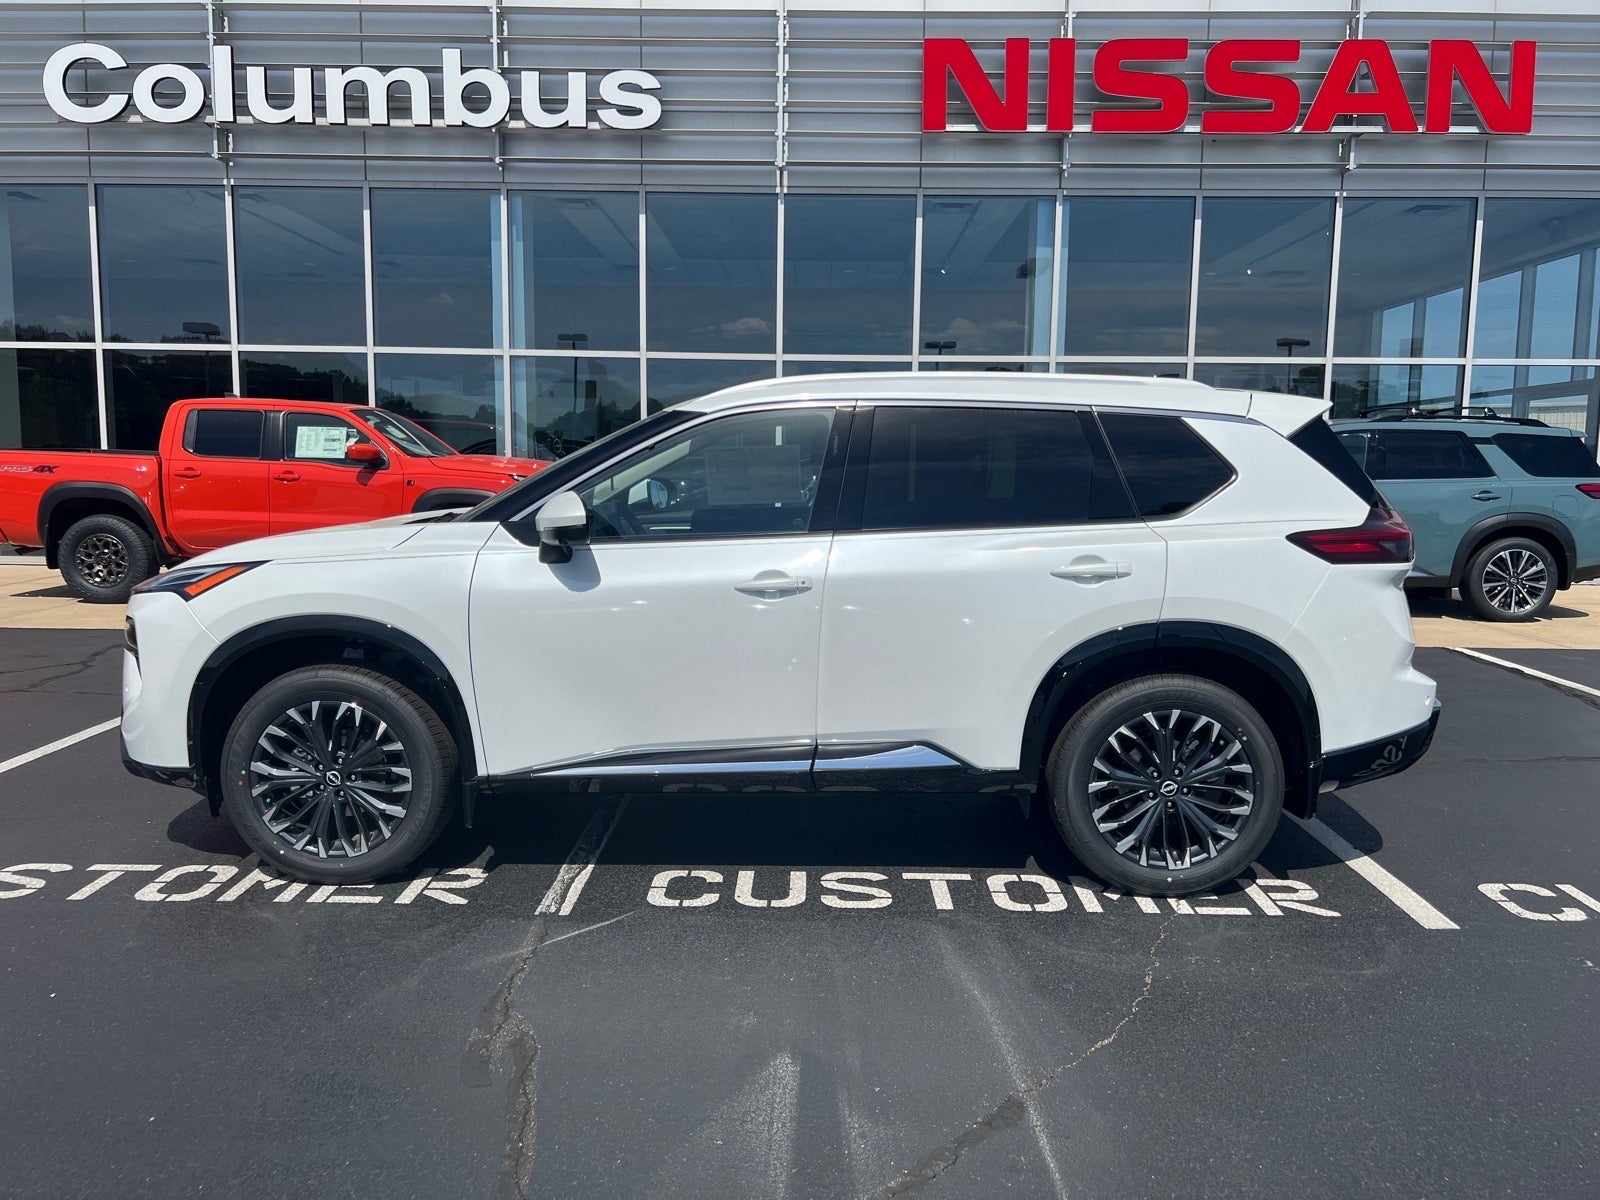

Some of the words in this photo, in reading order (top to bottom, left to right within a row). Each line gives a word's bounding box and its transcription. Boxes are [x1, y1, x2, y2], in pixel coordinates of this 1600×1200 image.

[42, 43, 662, 130] Columbus
[922, 38, 1537, 134] NISSAN
[646, 869, 1342, 917] CUSTOMER
